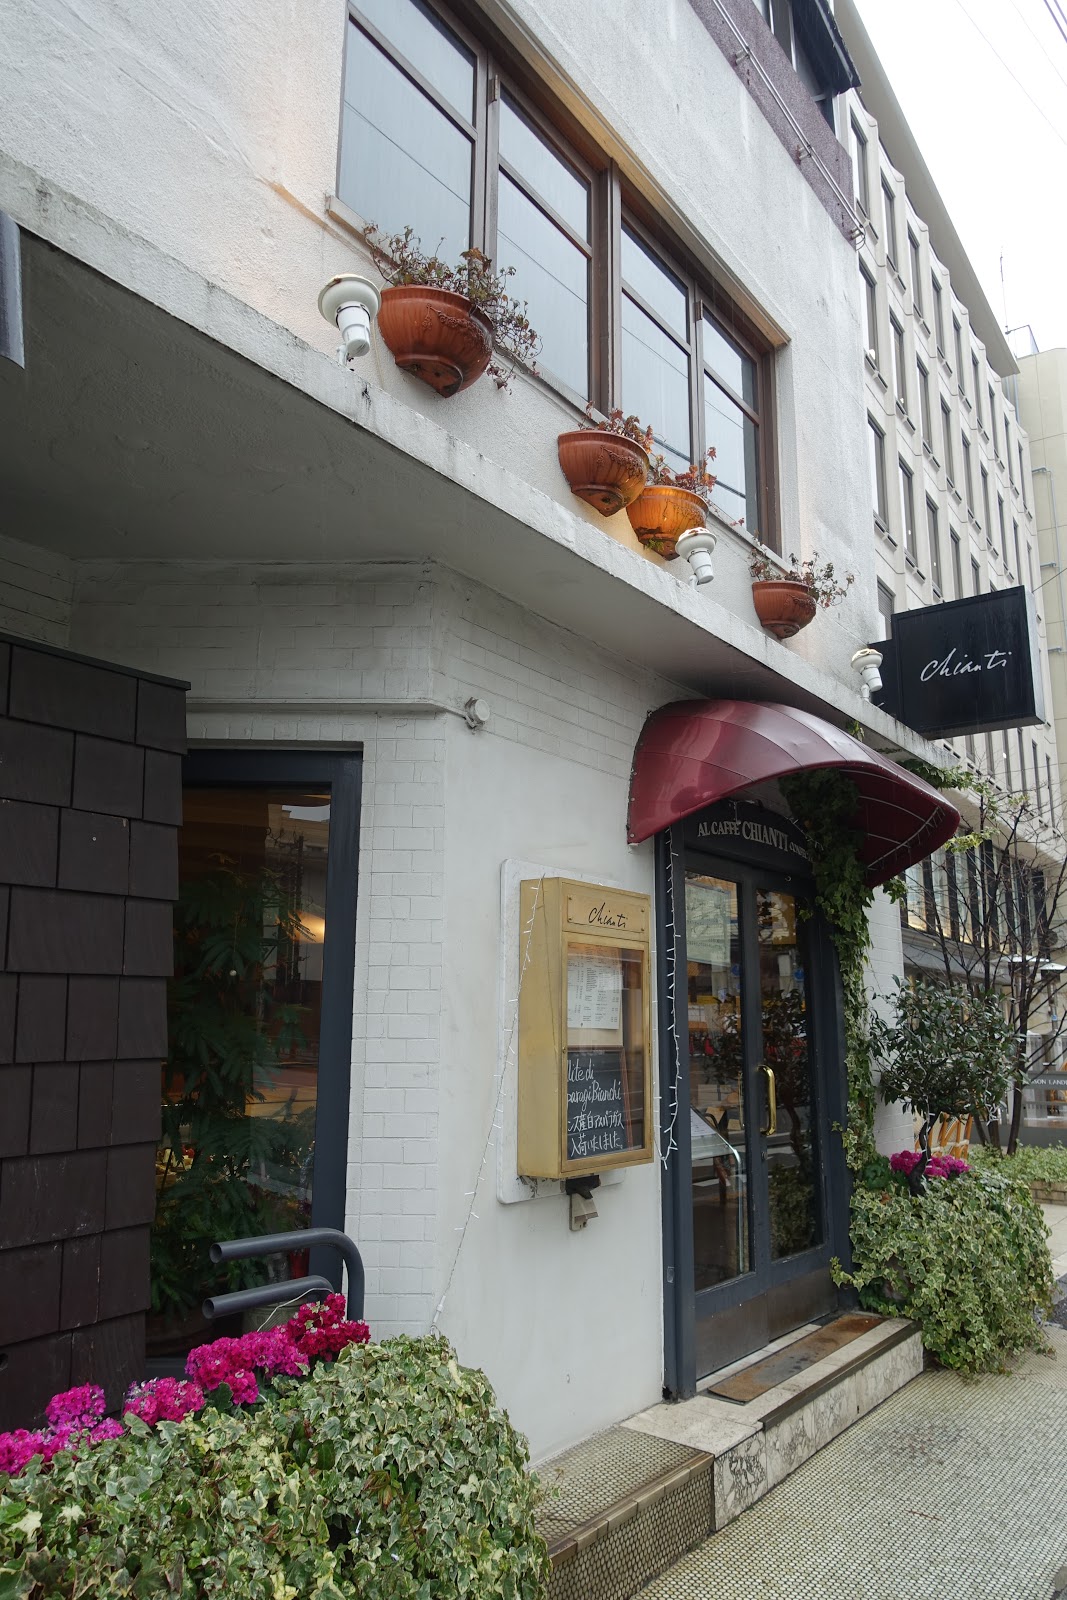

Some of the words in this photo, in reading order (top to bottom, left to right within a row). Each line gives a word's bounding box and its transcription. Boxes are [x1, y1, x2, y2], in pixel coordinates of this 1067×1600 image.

[920, 647, 1012, 682] Chianti
[697, 821, 711, 837] AL
[742, 821, 788, 851] CHIANTI
[588, 902, 628, 928] Chianti
[585, 1058, 595, 1081] di
